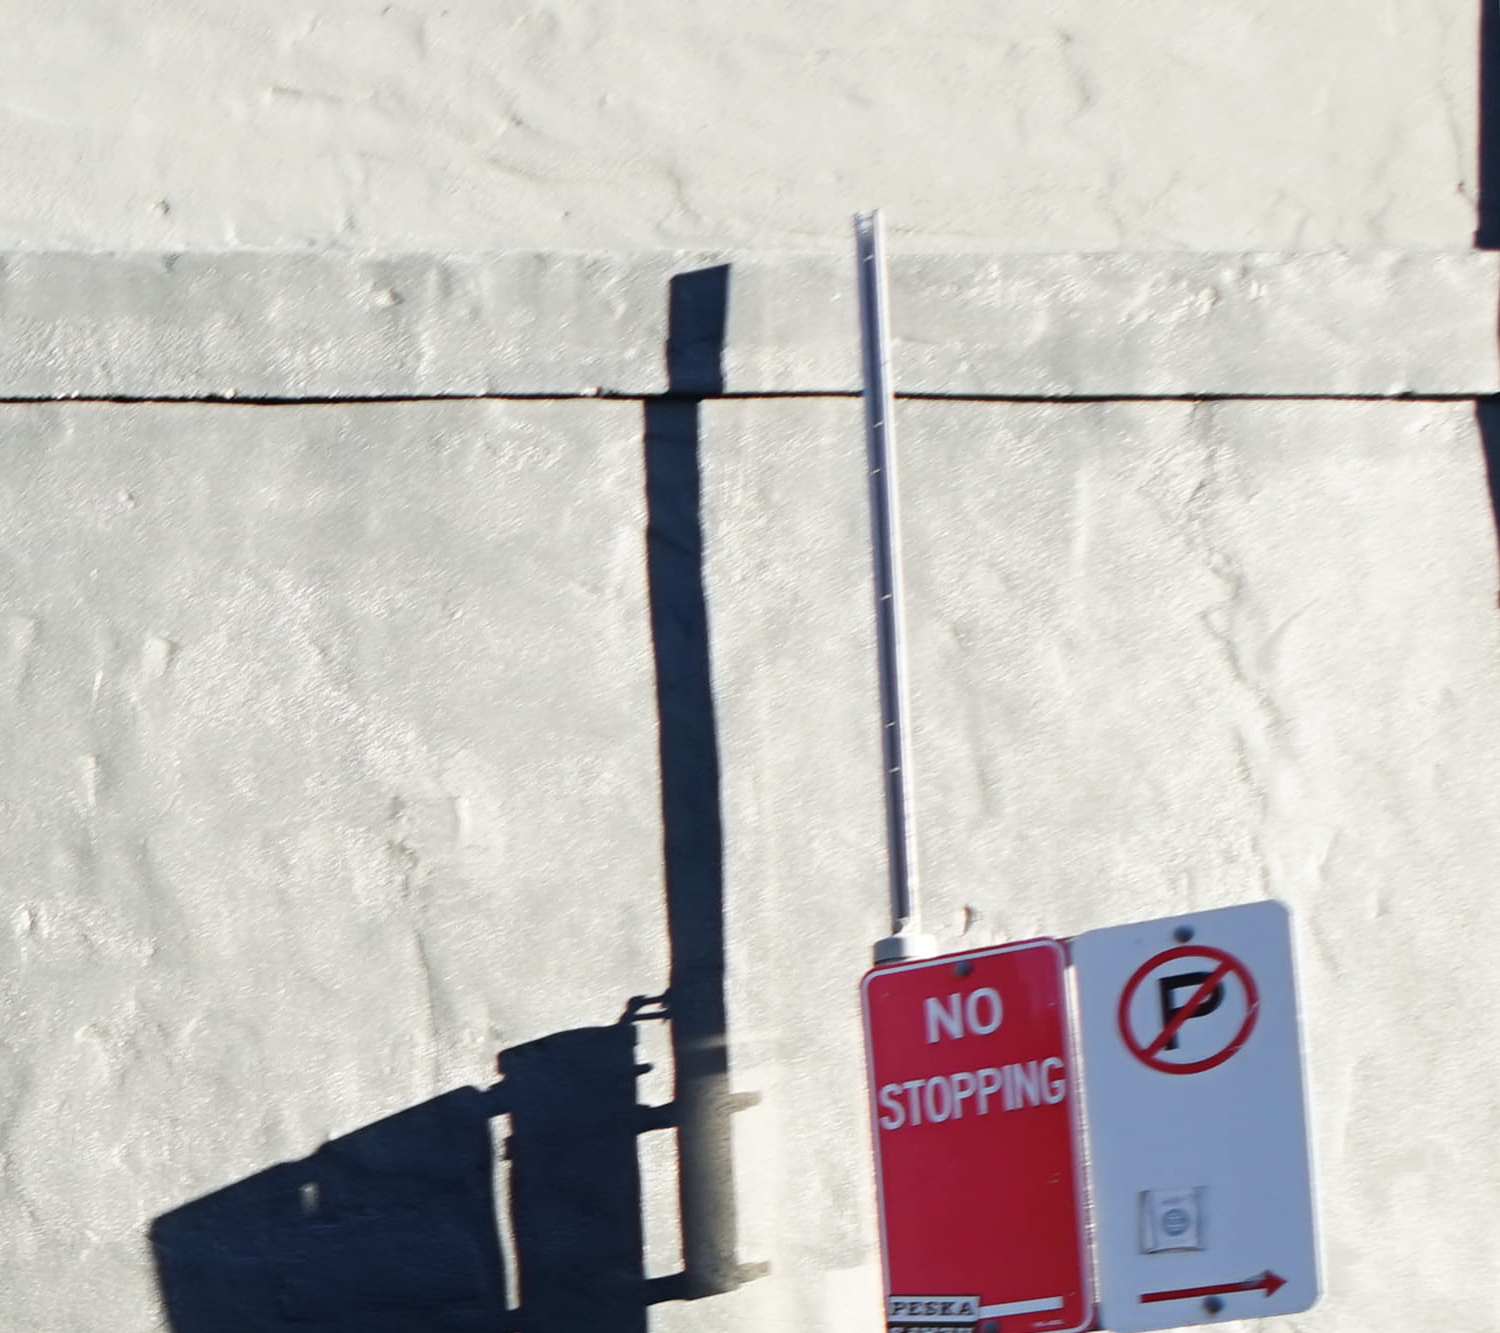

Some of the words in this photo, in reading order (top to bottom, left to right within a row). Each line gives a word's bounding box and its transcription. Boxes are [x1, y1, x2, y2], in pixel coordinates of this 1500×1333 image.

[925, 986, 1003, 1044] NO
[1157, 969, 1227, 1051] P
[878, 1056, 1067, 1132] STOPPING
[890, 1300, 976, 1316] PESKA
